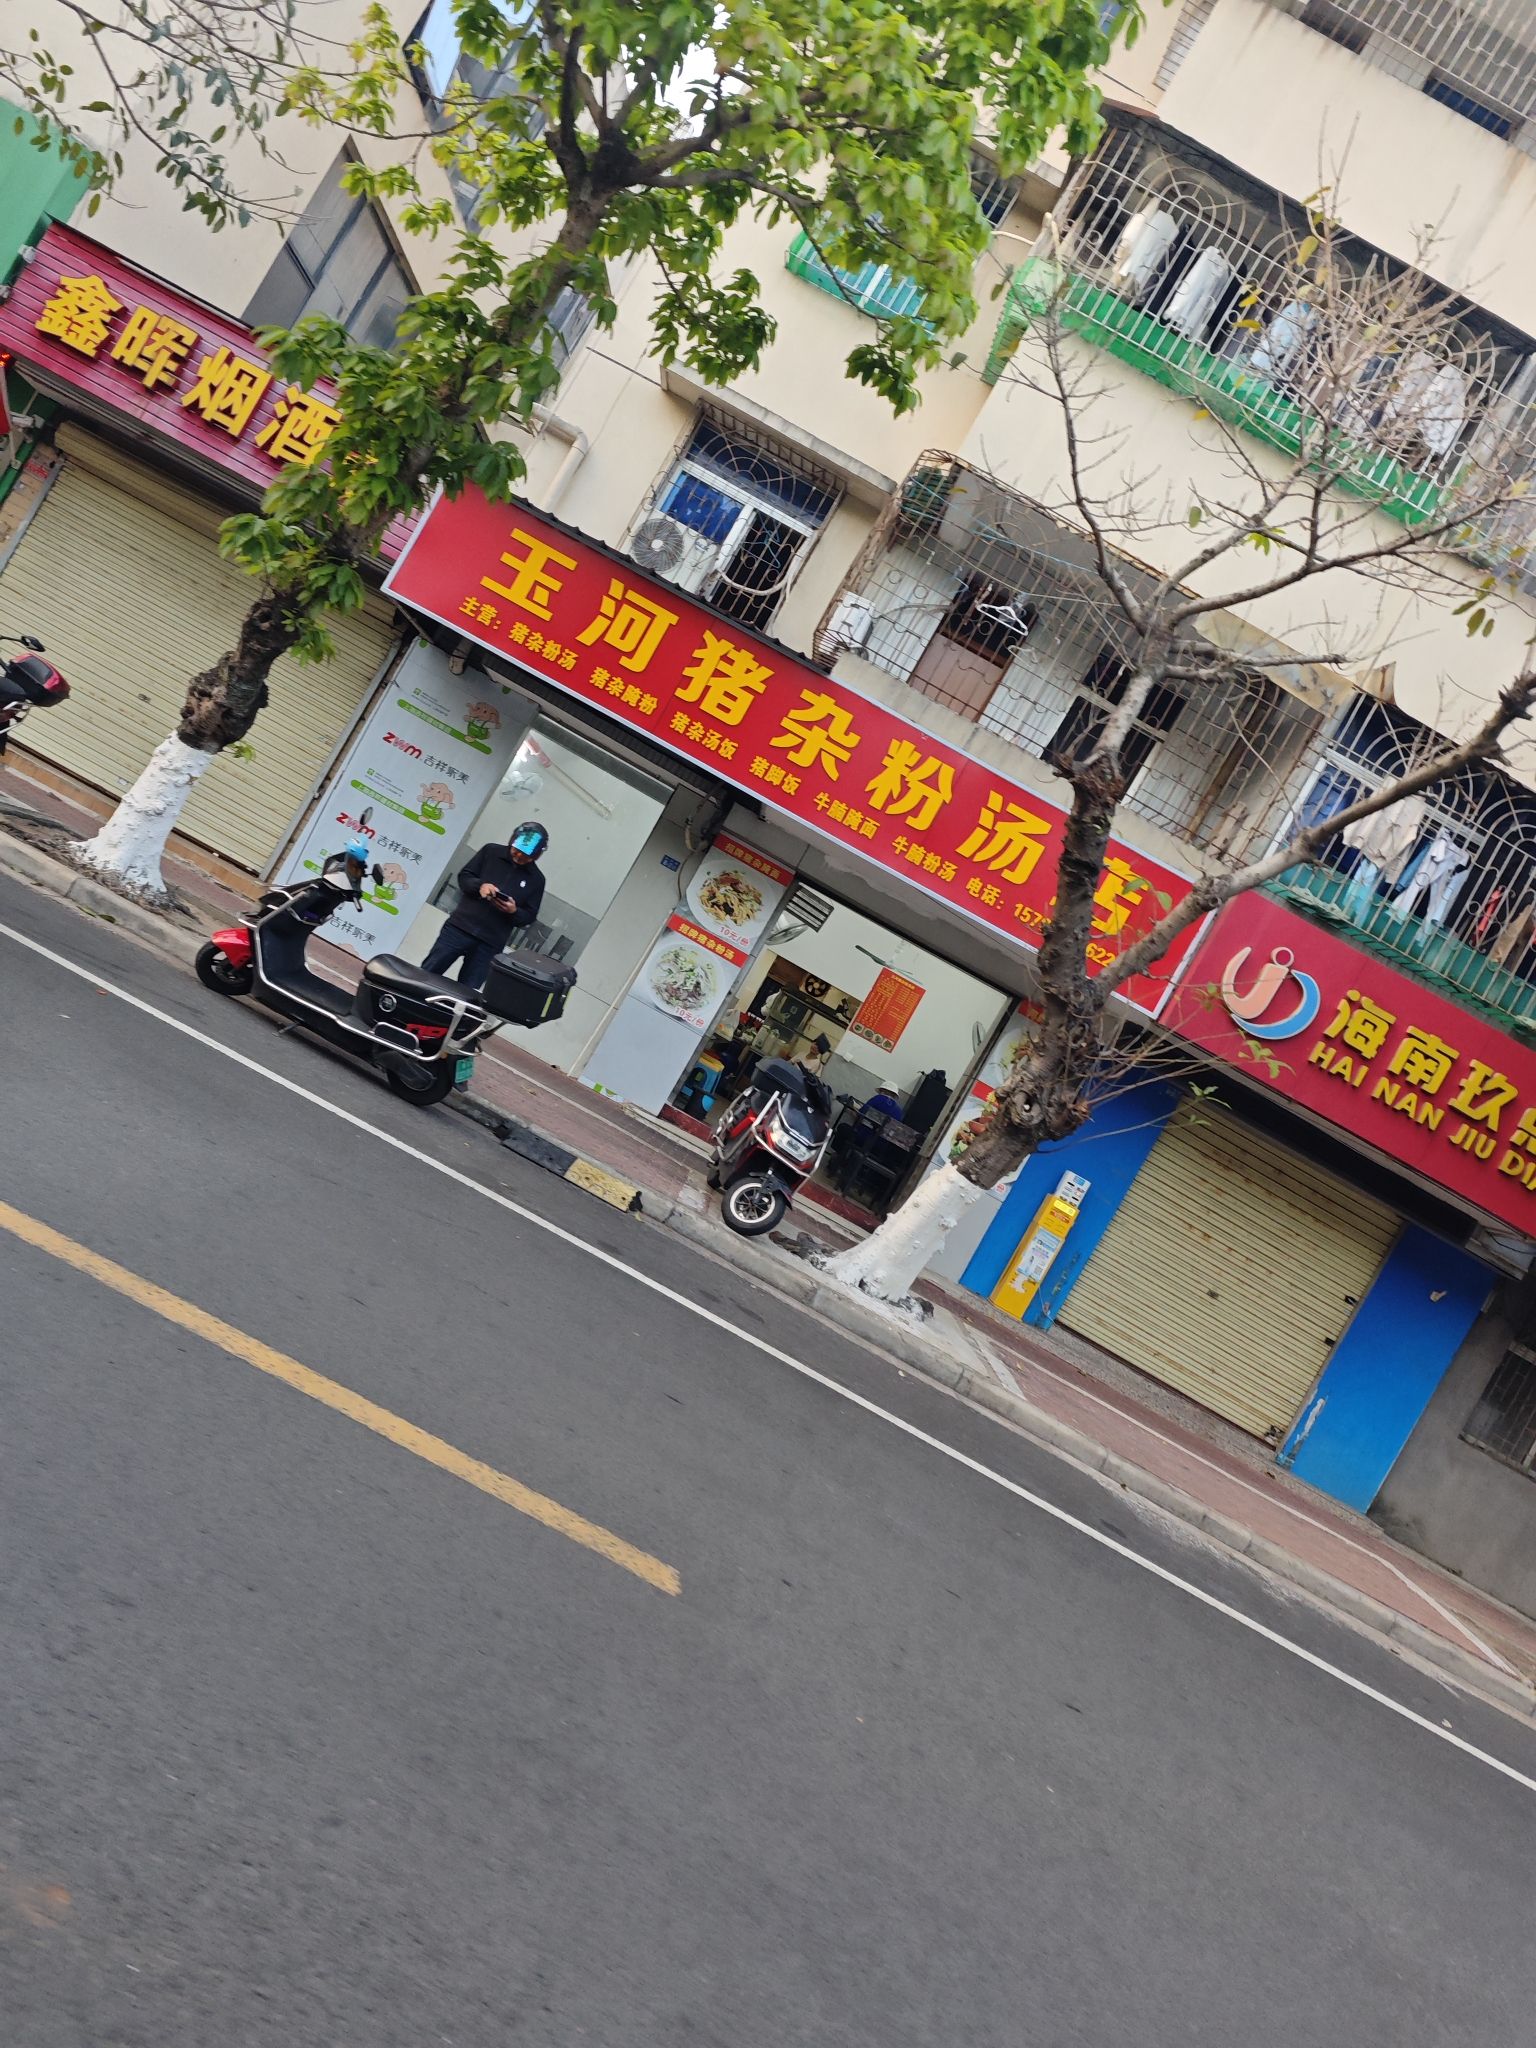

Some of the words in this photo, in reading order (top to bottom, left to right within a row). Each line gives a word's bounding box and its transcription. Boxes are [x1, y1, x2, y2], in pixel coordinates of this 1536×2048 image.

[36, 274, 379, 514] 鑫晖烟酒
[479, 528, 1153, 937] 玉河猪杂粉汤店
[589, 667, 659, 716] 猪杂腌粉
[669, 711, 739, 761] 猪杂汤饭
[748, 755, 802, 796] 猪脚饭
[891, 836, 959, 883] 牛腩粉汤
[1308, 1041, 1369, 1088] HAI
[1372, 1077, 1445, 1131] NAN
[1448, 1123, 1497, 1159] JIU
[1498, 1149, 1536, 1191] DI
